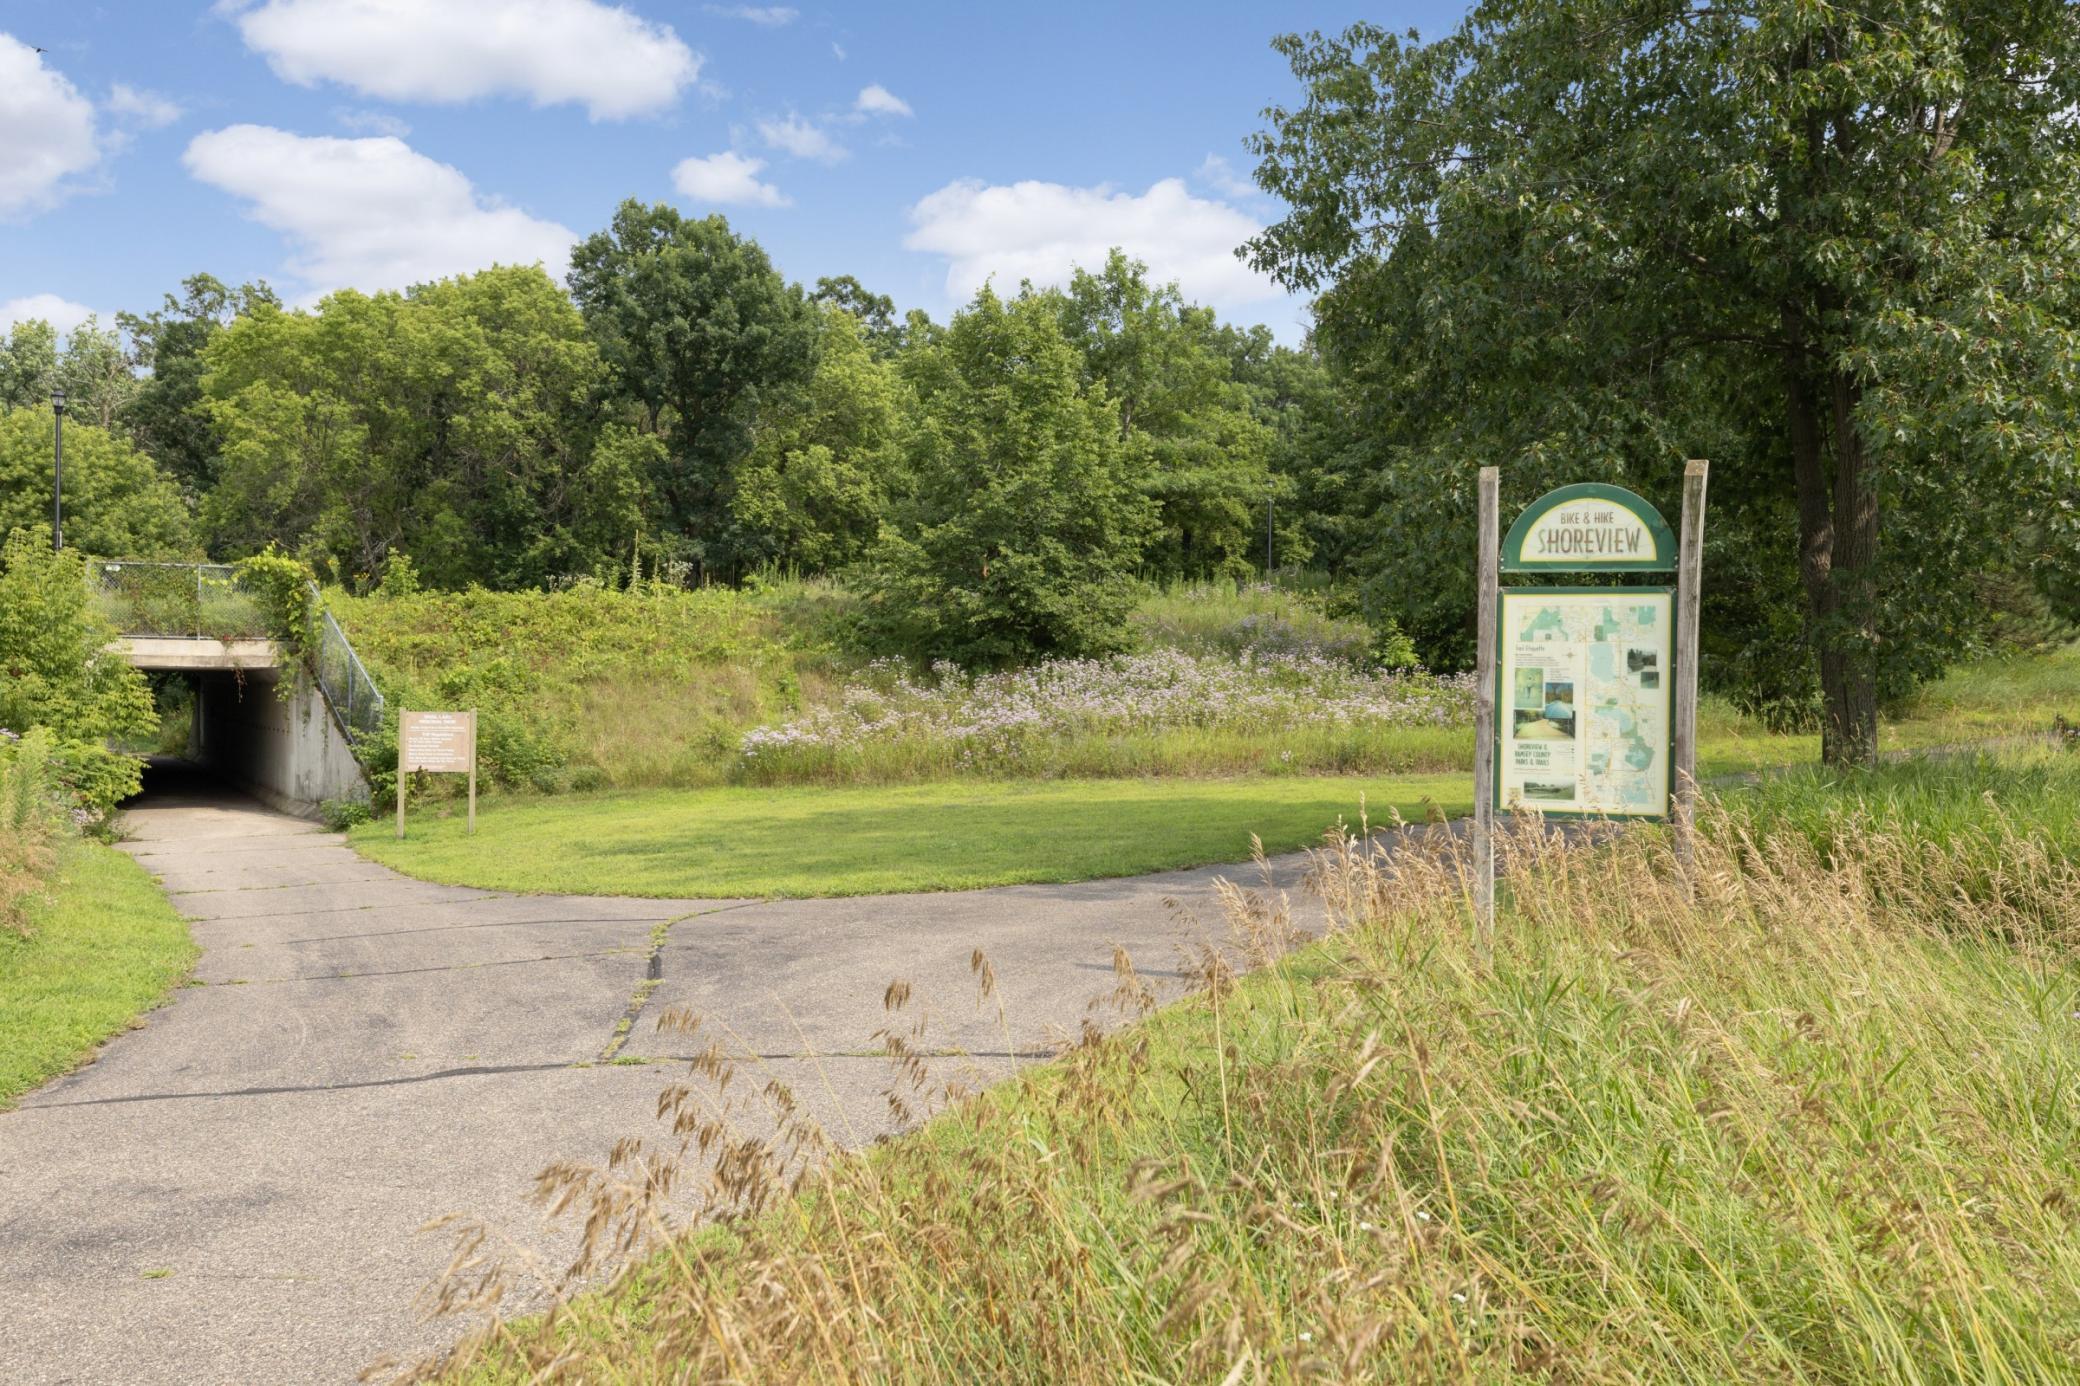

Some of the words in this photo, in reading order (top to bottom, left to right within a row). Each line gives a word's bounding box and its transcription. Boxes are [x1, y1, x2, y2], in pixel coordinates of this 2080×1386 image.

[1560, 512, 1580, 525] BIKE
[1583, 511, 1590, 525] &
[1594, 511, 1614, 524] HIKE
[1538, 527, 1641, 554] SHOREVIEW
